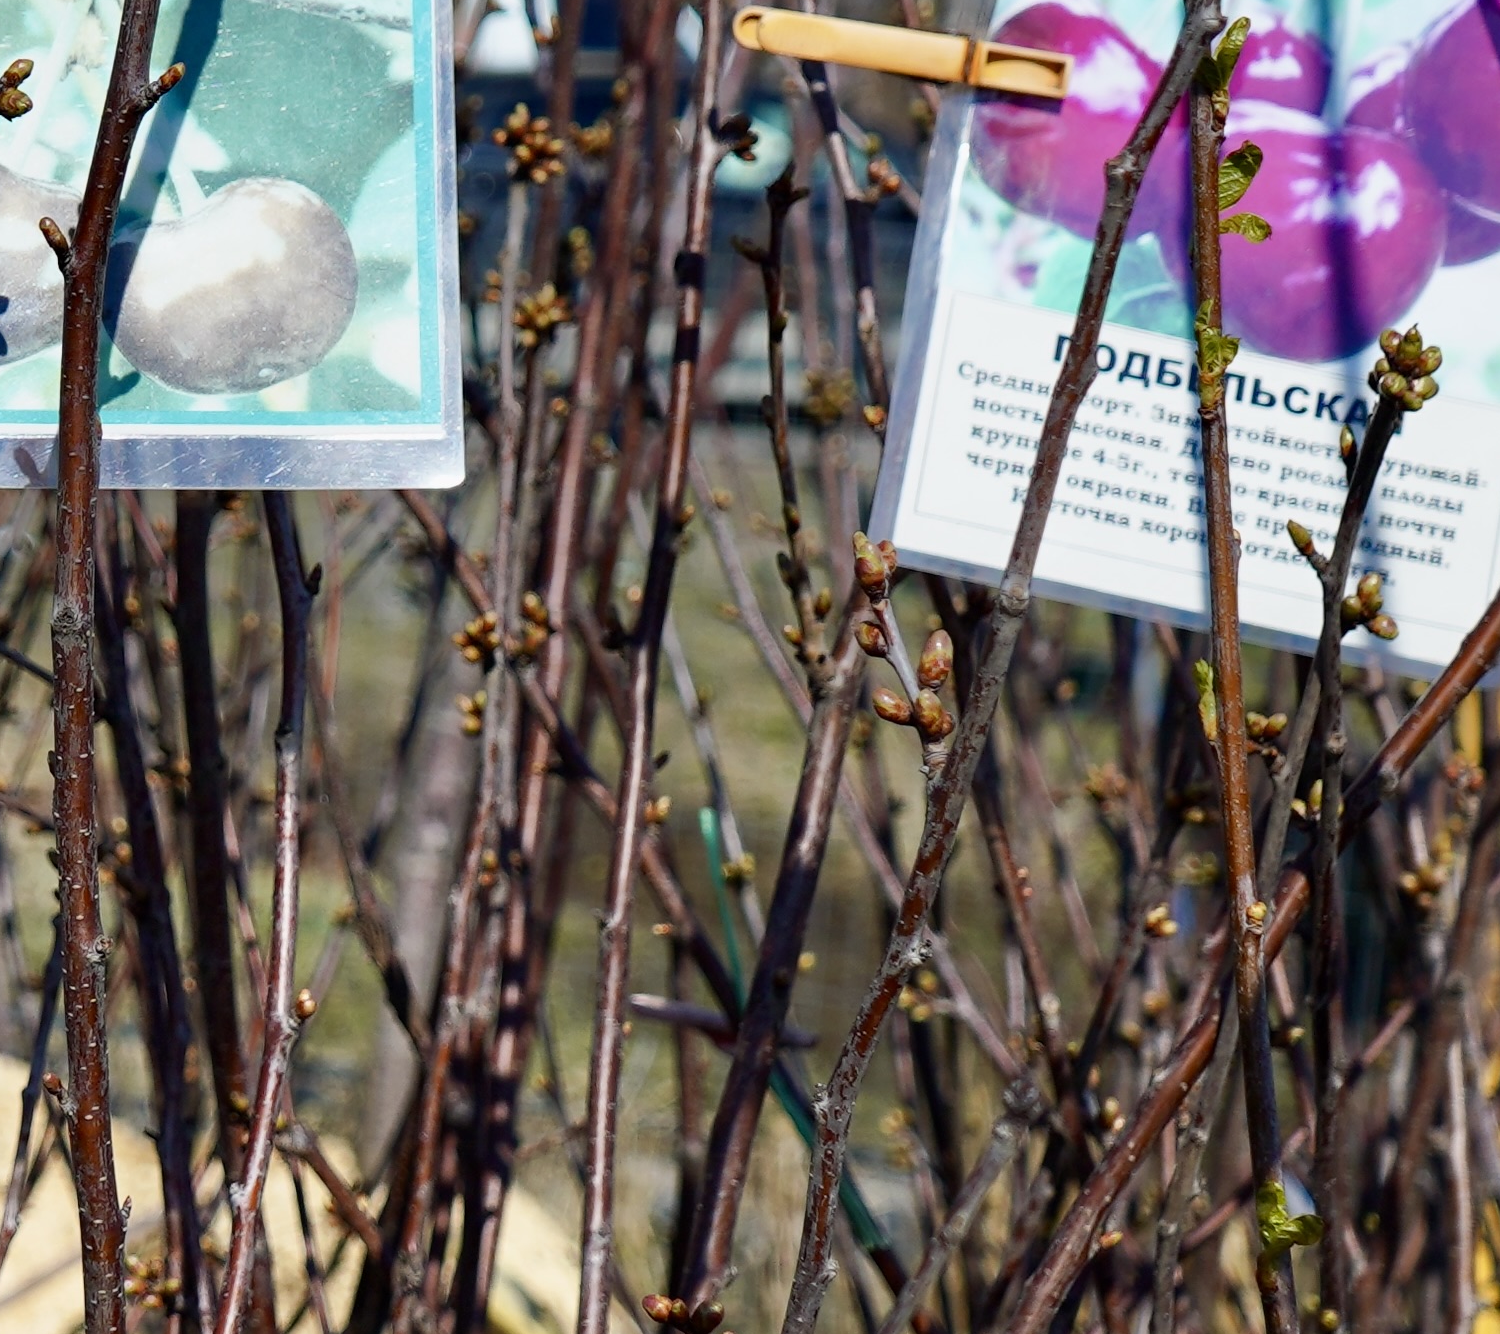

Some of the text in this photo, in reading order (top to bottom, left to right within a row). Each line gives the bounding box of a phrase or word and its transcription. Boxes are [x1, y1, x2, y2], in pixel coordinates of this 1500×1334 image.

[958, 360, 1052, 397] Средни
[1082, 392, 1141, 419] орт.
[965, 451, 1036, 479] черно
[1066, 472, 1176, 510] окраски.
[970, 423, 1083, 460] крупе
[1379, 513, 1456, 541] почти
[973, 396, 1044, 423] ность
[1072, 419, 1169, 453] ысокая.
[1381, 485, 1464, 514] плоды
